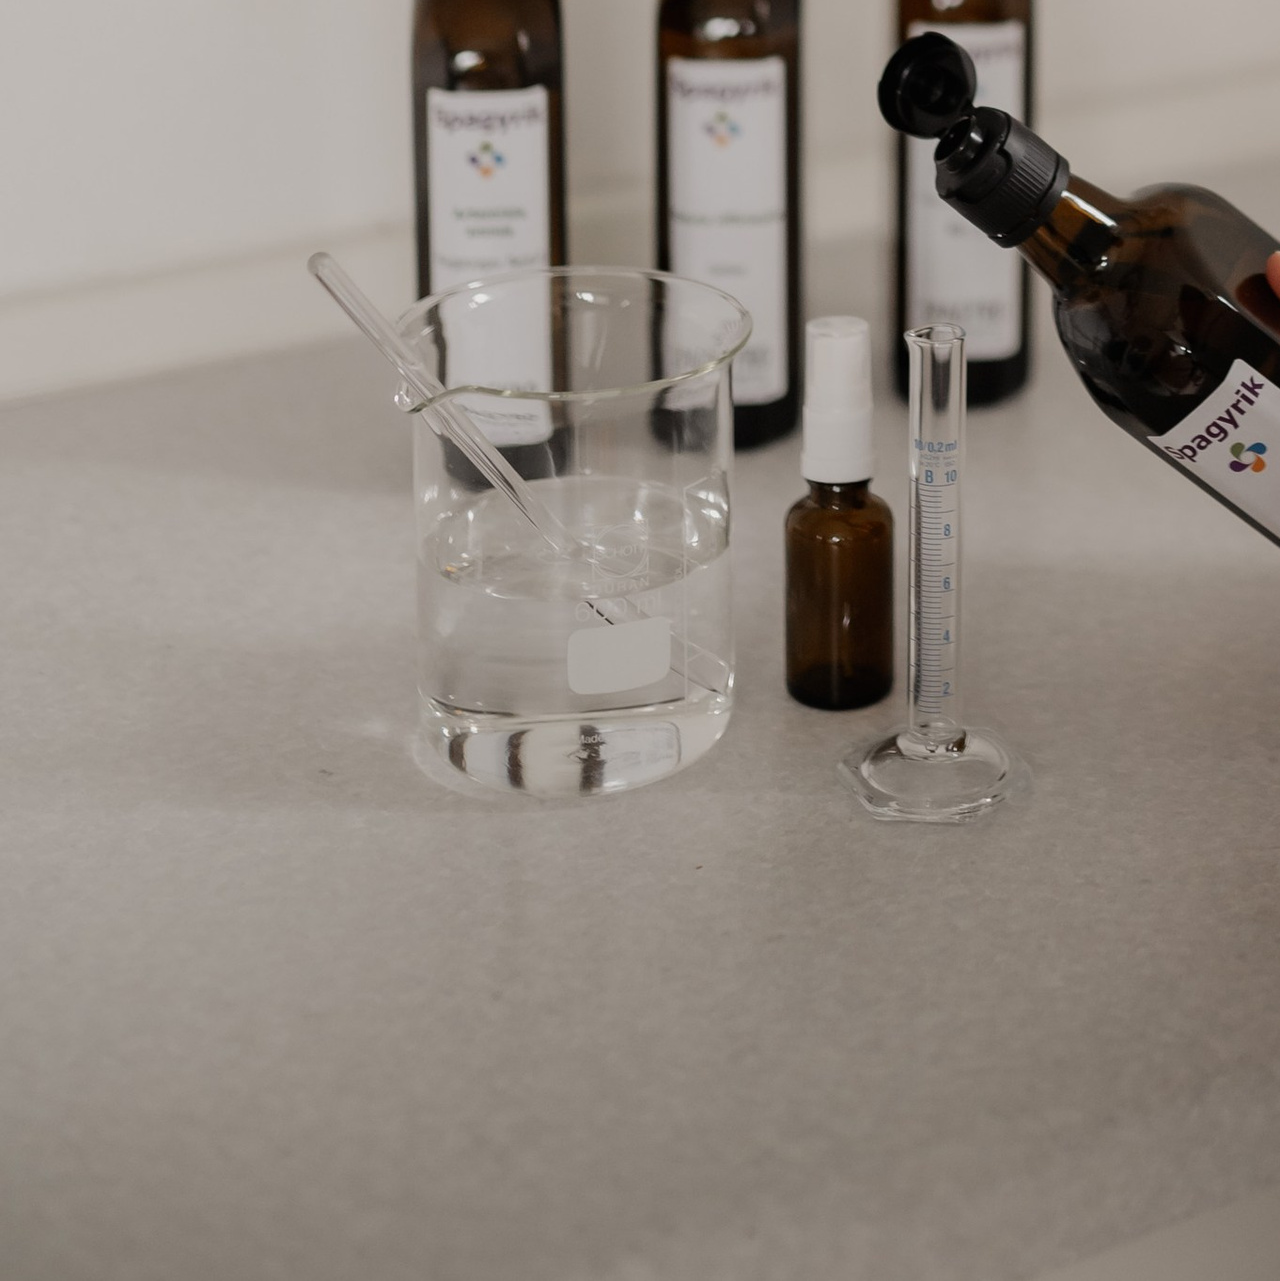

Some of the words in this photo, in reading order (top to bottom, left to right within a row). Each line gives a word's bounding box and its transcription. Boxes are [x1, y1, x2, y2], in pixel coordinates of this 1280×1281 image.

[1164, 375, 1264, 462] Spagyrik
[925, 469, 934, 484] B
[944, 469, 957, 483] 10
[943, 523, 951, 536] 8
[943, 576, 950, 590] 6
[943, 630, 950, 643] 4
[943, 682, 950, 695] 2
